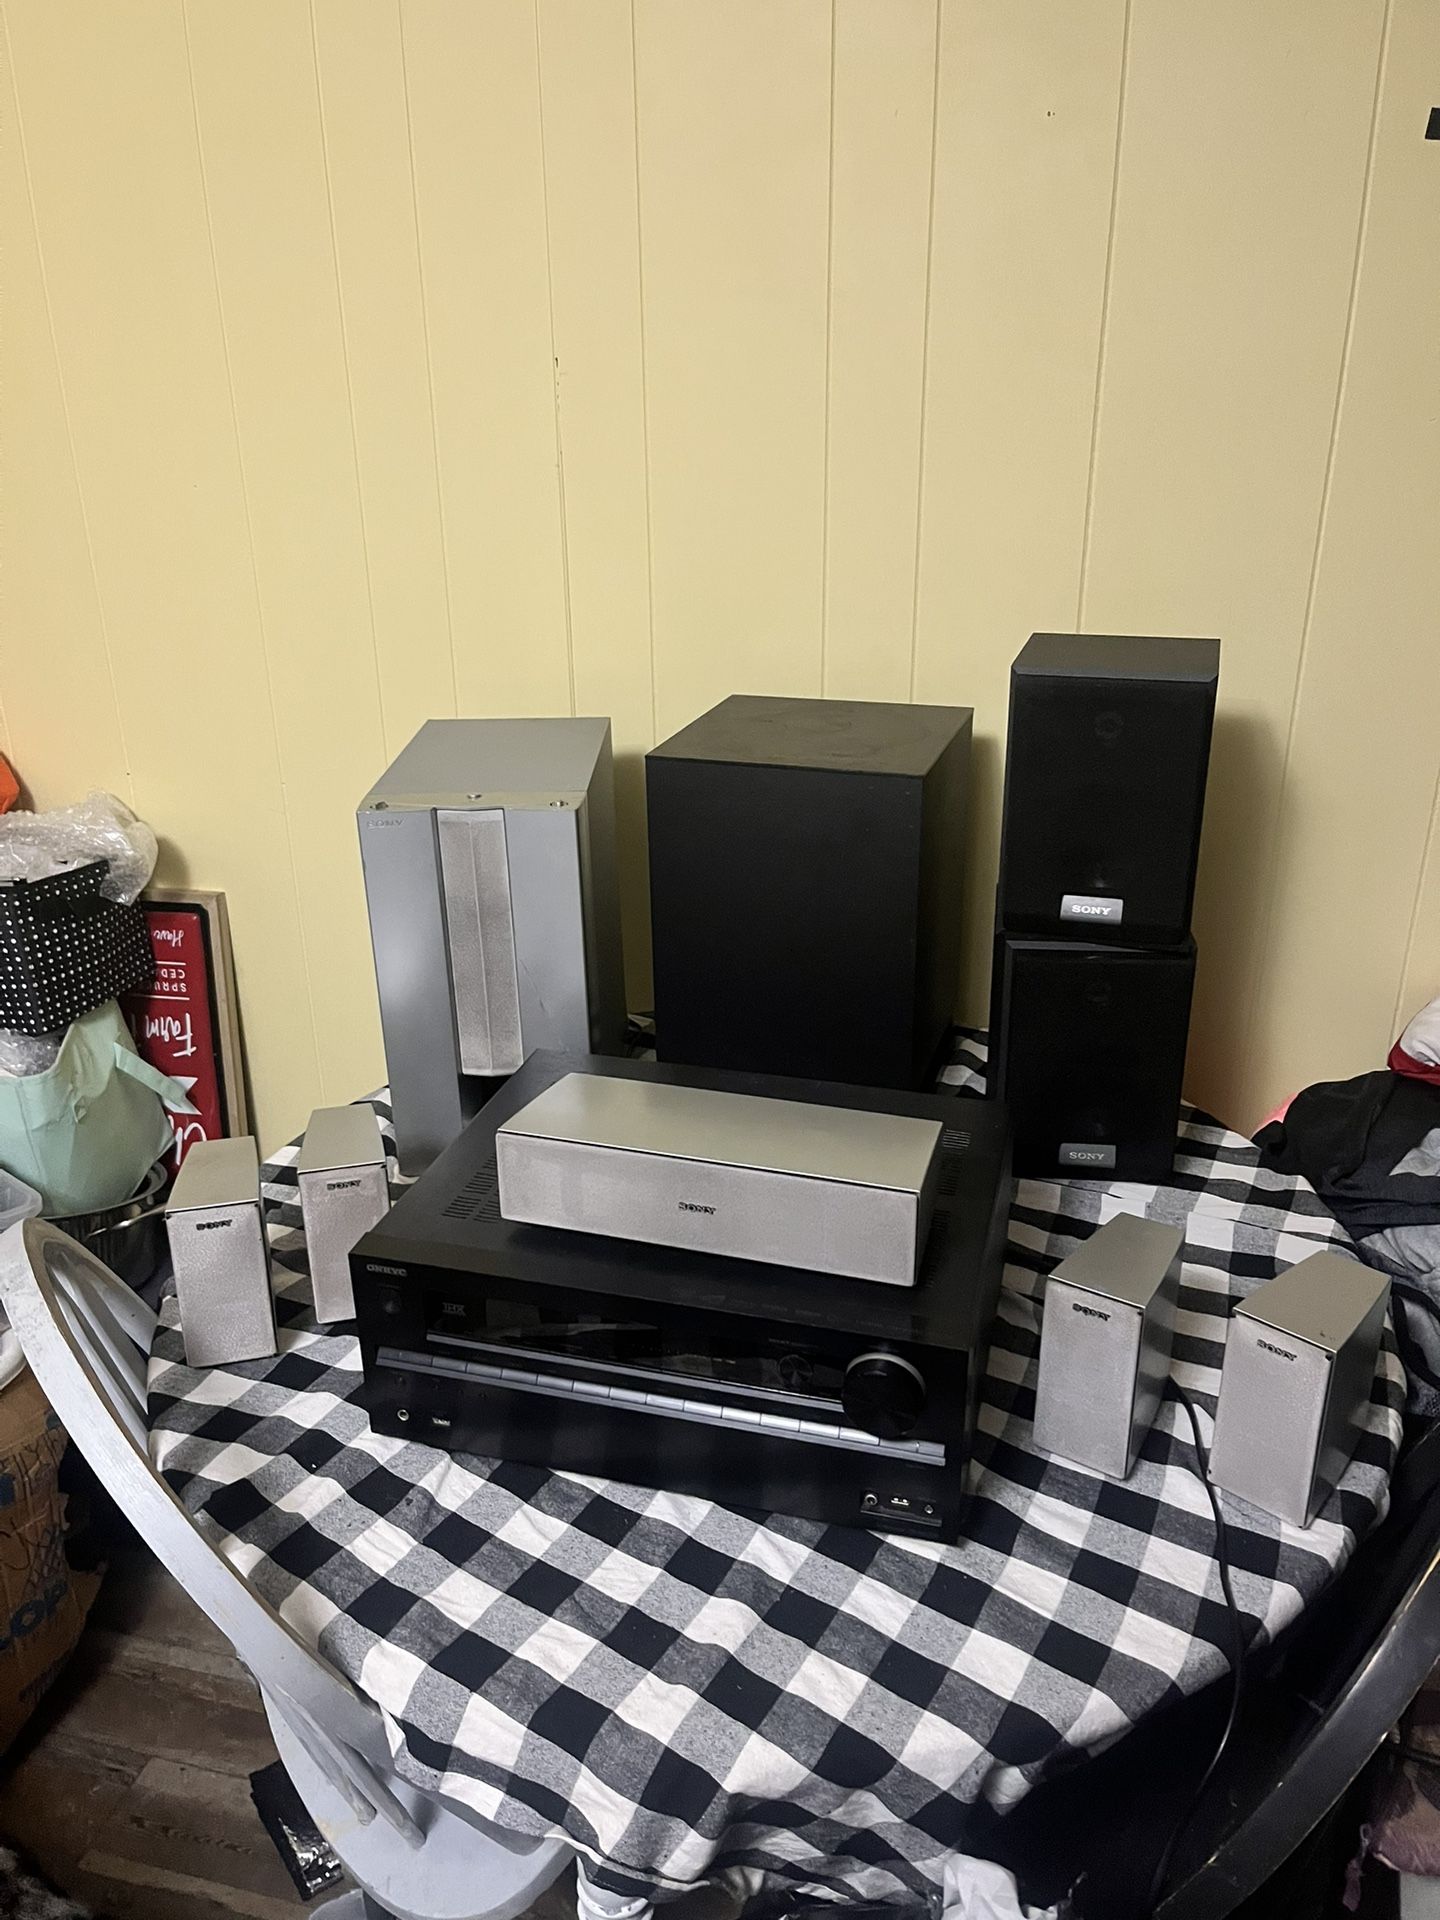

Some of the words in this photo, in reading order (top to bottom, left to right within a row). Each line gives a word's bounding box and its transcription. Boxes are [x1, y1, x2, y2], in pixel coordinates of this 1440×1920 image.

[1071, 904, 1112, 916] SONY
[157, 968, 186, 980] CED
[151, 981, 188, 993] SPRU
[145, 1012, 198, 1058] Farm
[1069, 1151, 1105, 1160] SONY
[327, 1179, 361, 1191] SONY
[678, 1201, 716, 1215] SONY
[196, 1219, 232, 1231] SONY
[1072, 1303, 1111, 1322] SONY
[1257, 1339, 1297, 1362] SONY
